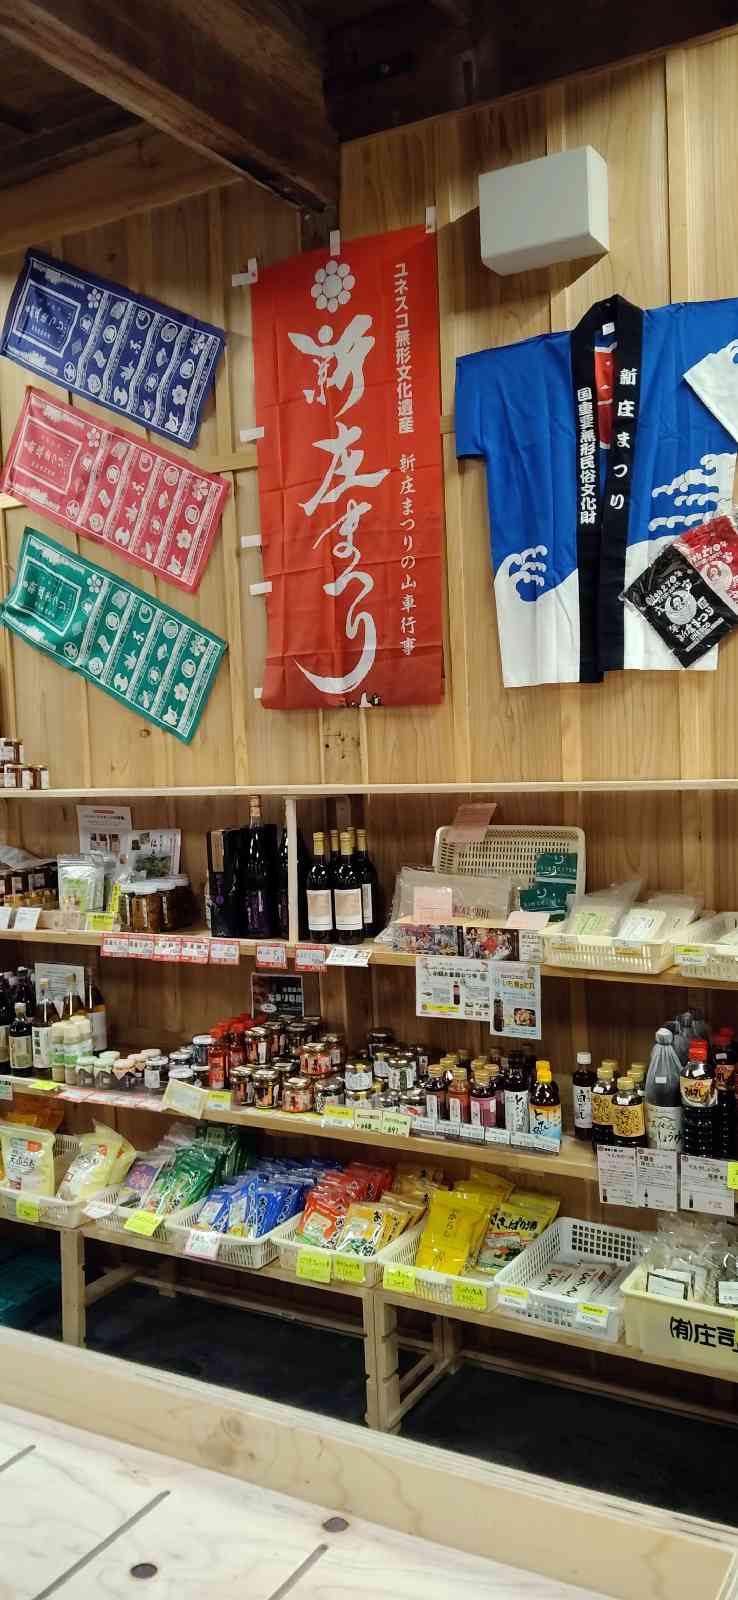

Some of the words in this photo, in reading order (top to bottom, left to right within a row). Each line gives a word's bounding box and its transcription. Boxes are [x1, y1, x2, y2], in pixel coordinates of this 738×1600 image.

[394, 262, 414, 434] ユネスコ無形文化遺産
[577, 386, 597, 526] 国重要無形民俗文化財
[610, 367, 638, 511] 新庄まつり
[399, 453, 417, 657] 新庄まつりの山車行事
